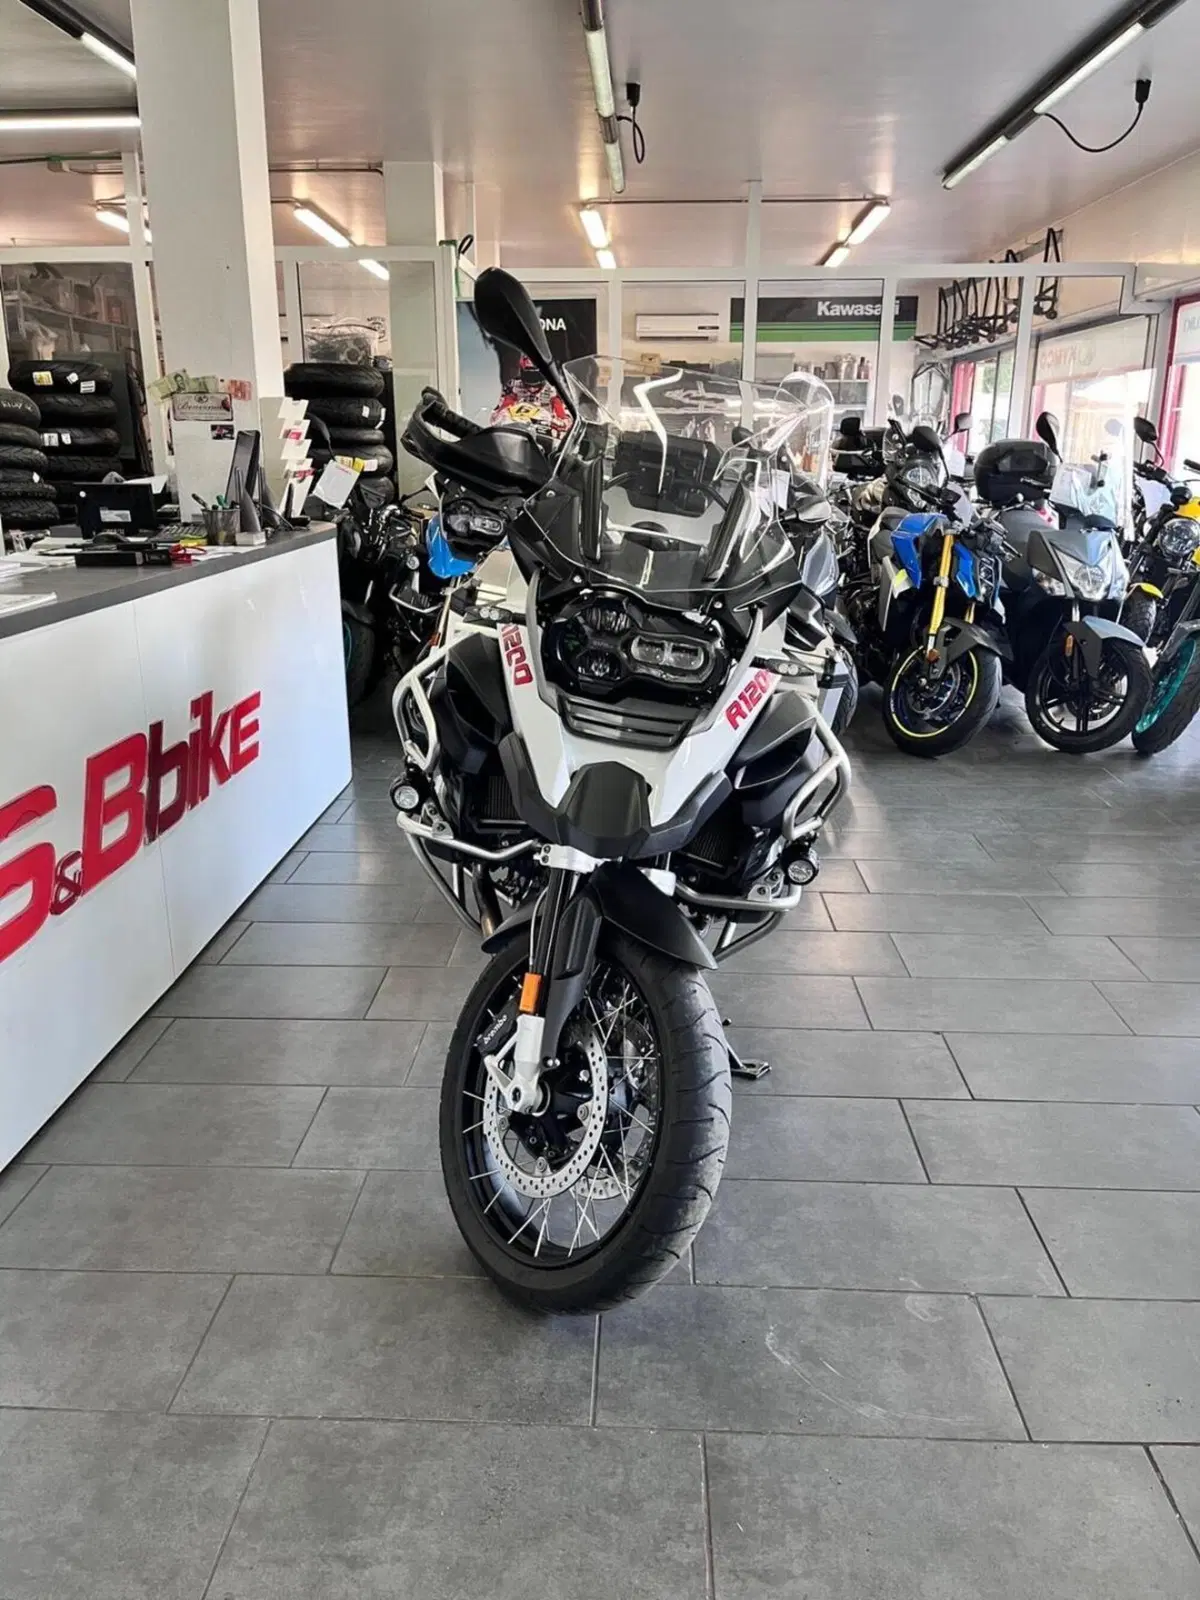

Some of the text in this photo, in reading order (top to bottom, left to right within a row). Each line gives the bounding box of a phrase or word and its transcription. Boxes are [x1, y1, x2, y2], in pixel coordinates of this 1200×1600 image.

[817, 300, 900, 316] Kawasai
[501, 625, 533, 685] 1200
[725, 669, 771, 731] R120
[483, 1014, 507, 1045] brembo
